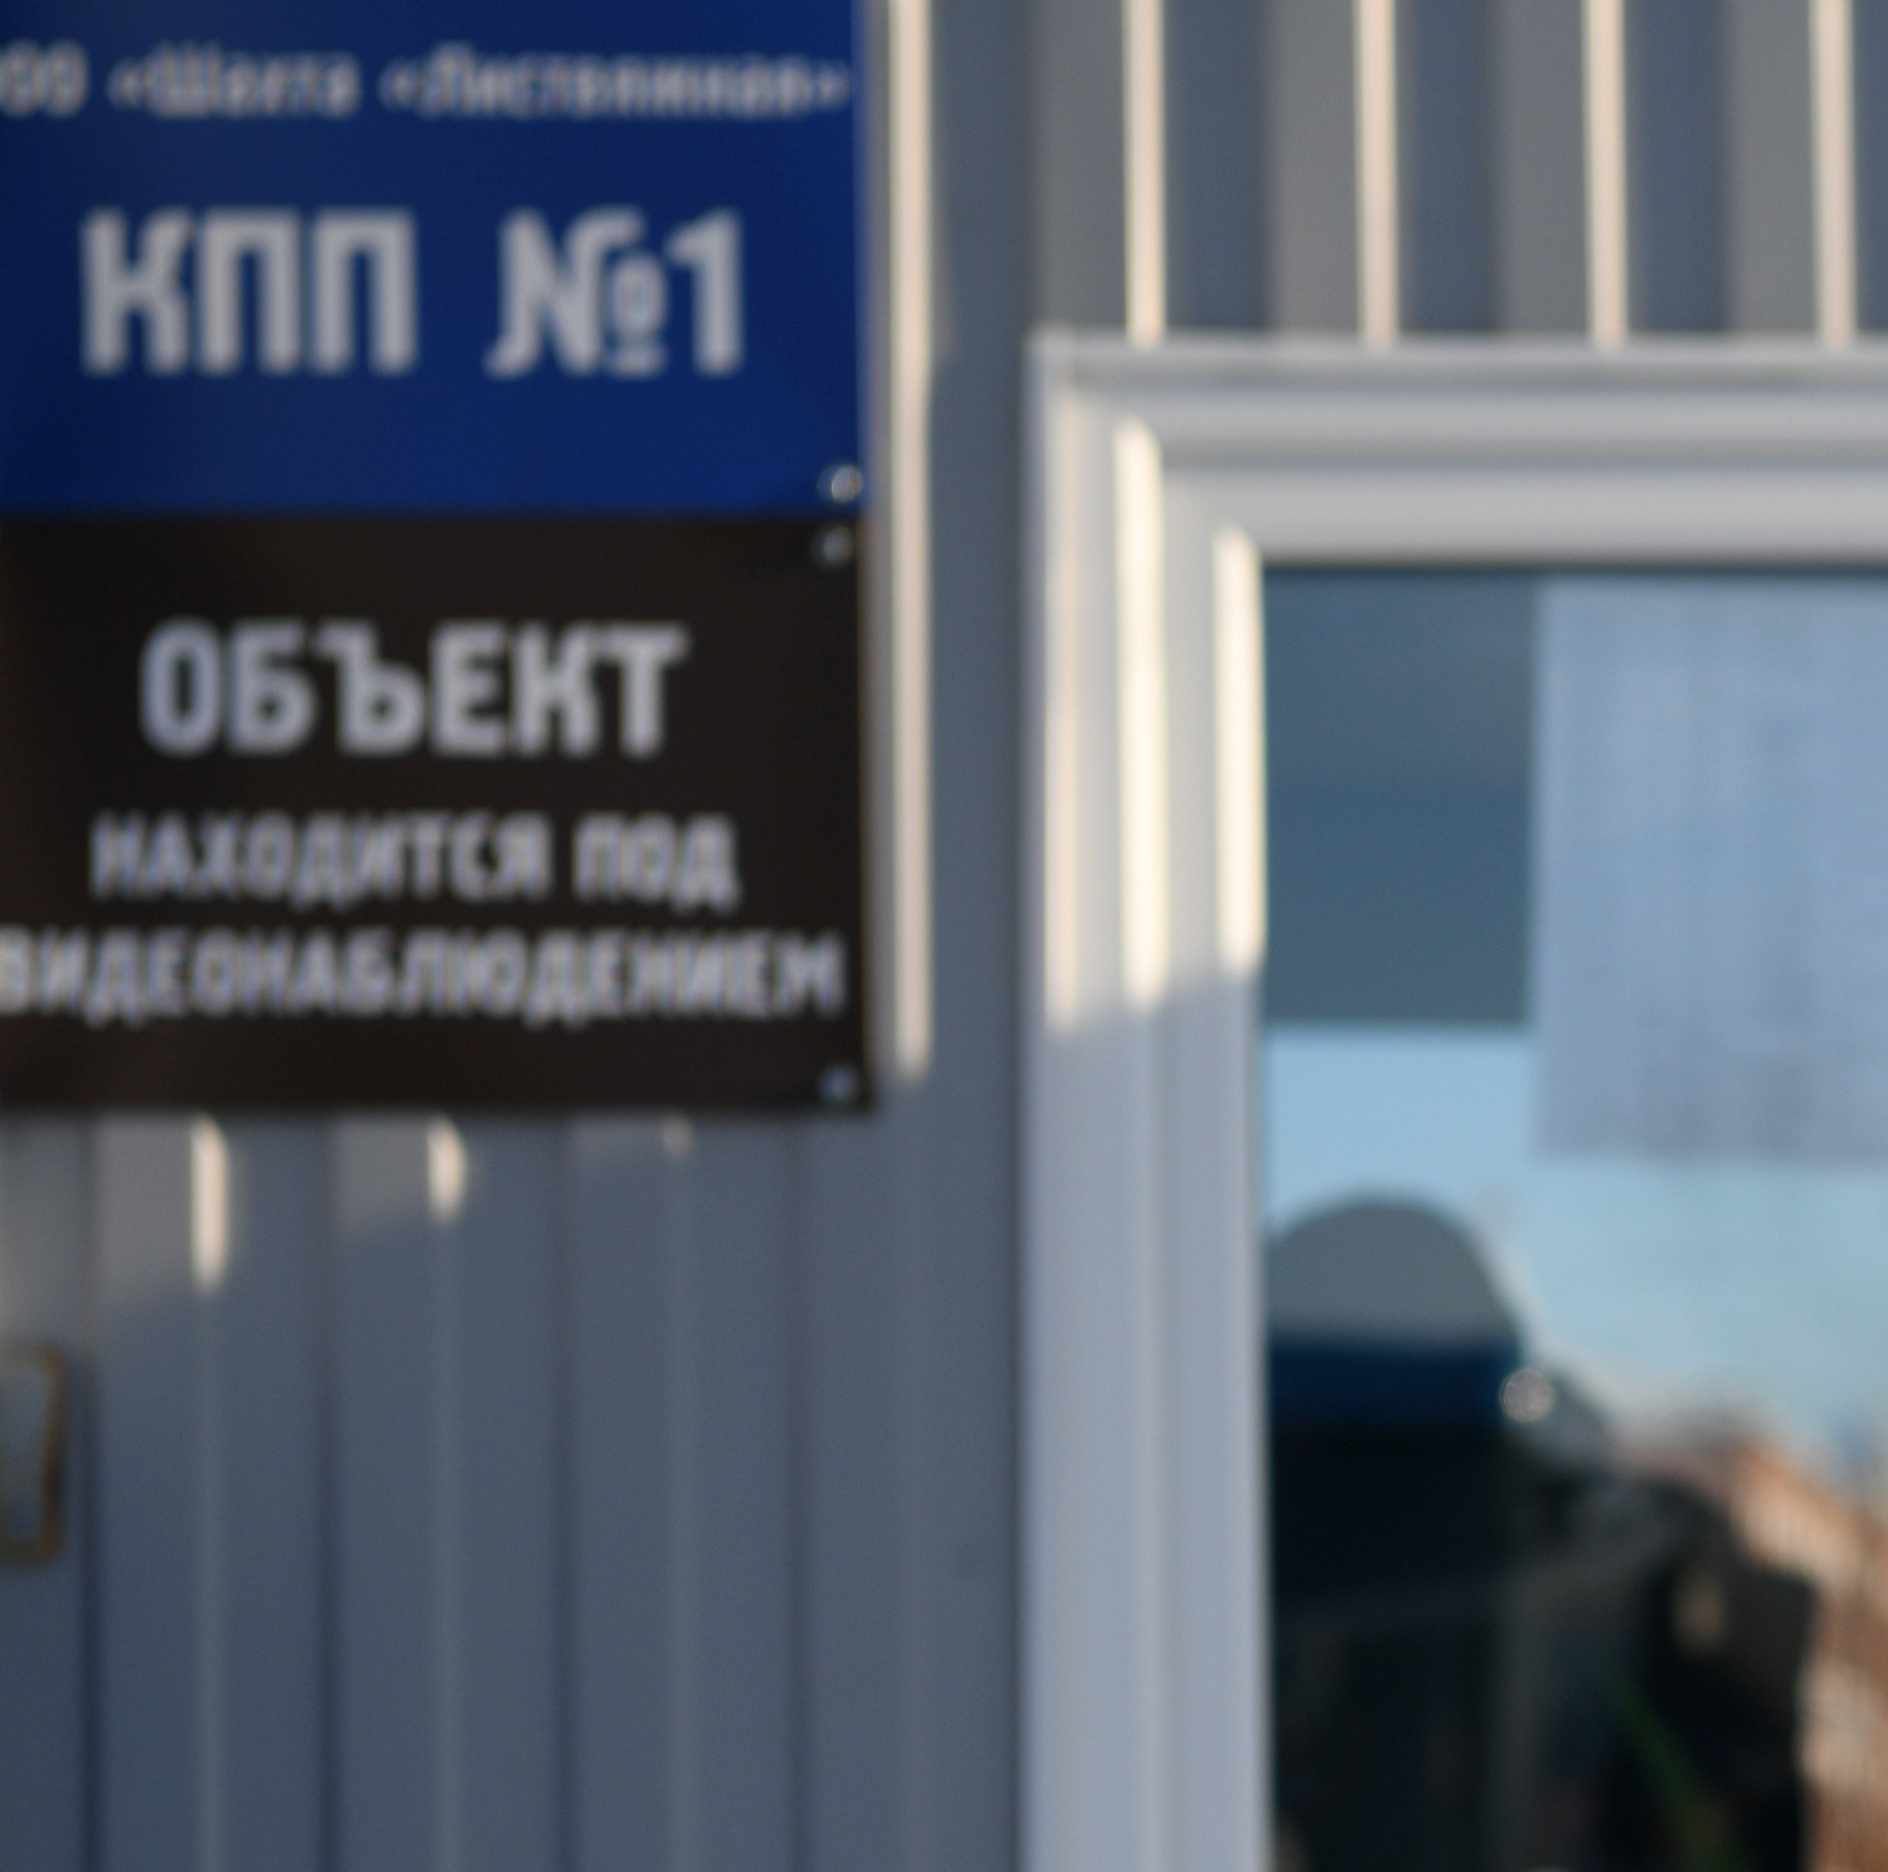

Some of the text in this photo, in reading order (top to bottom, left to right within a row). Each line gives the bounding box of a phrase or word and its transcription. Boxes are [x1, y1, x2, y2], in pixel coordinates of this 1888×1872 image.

[0, 42, 850, 118] ОО «Шахта «Листвяжная»
[83, 210, 741, 375] КПП №1
[143, 623, 686, 755] ОБЪЕКТ
[92, 814, 738, 907] НАХОДИТСЯ ПОД
